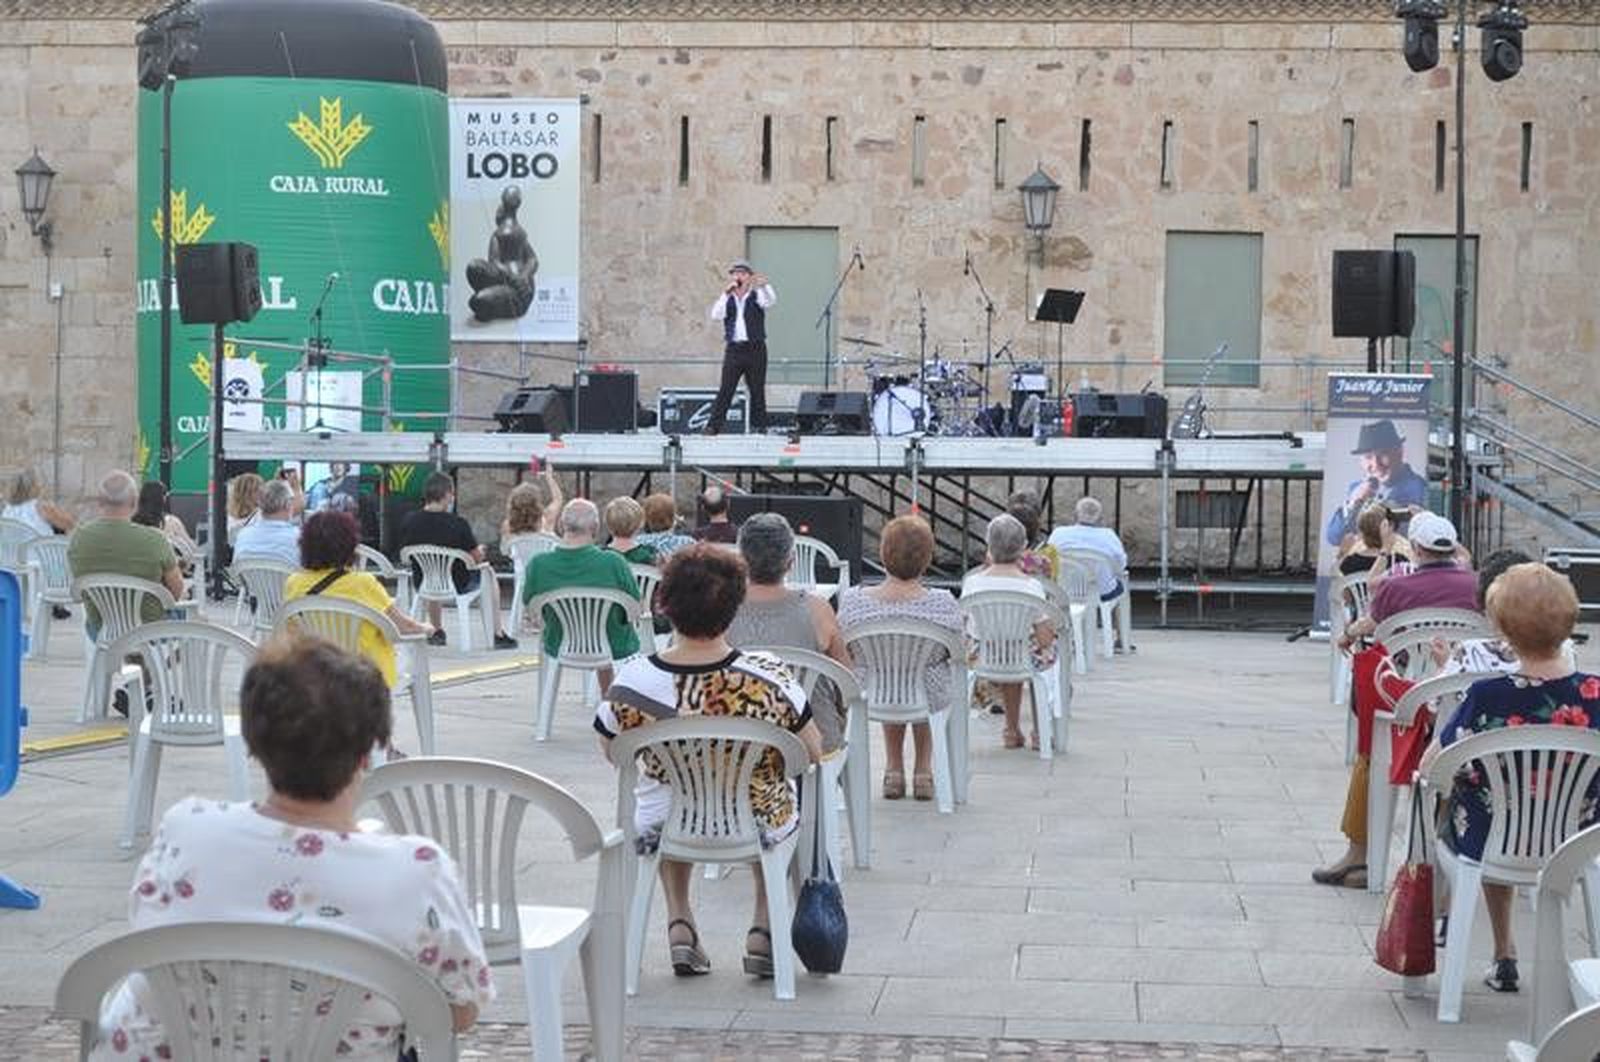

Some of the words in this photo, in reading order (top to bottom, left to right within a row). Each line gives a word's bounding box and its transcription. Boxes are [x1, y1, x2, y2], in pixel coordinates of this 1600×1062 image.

[467, 111, 559, 125] MUSEO
[466, 130, 559, 147] BALTASAR
[467, 152, 559, 179] LOBO
[269, 175, 320, 193] CAJA
[325, 176, 390, 196] RURAL
[372, 279, 439, 315] CAJA
